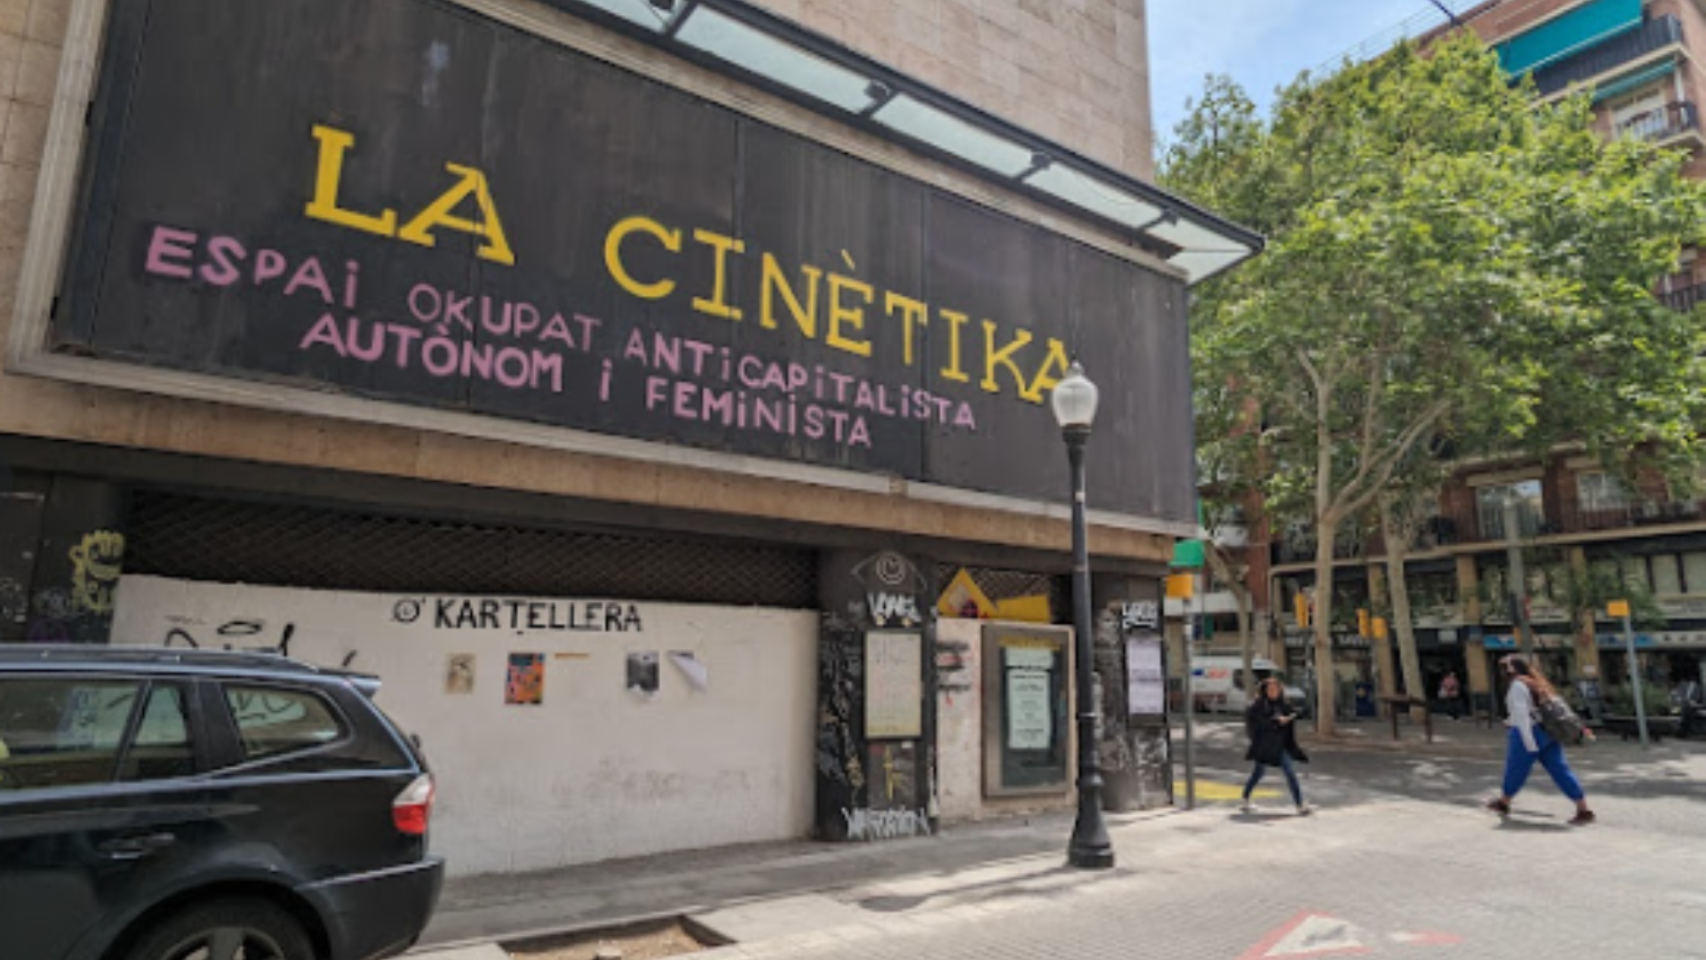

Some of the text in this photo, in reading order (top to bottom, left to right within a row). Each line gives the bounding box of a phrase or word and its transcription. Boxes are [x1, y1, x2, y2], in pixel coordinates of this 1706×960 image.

[305, 125, 1072, 404] LA CINÈTIKA
[301, 313, 563, 391] AUTÒNOM
[408, 283, 602, 353] OKUPAT
[434, 598, 642, 632] KARTELLERA
